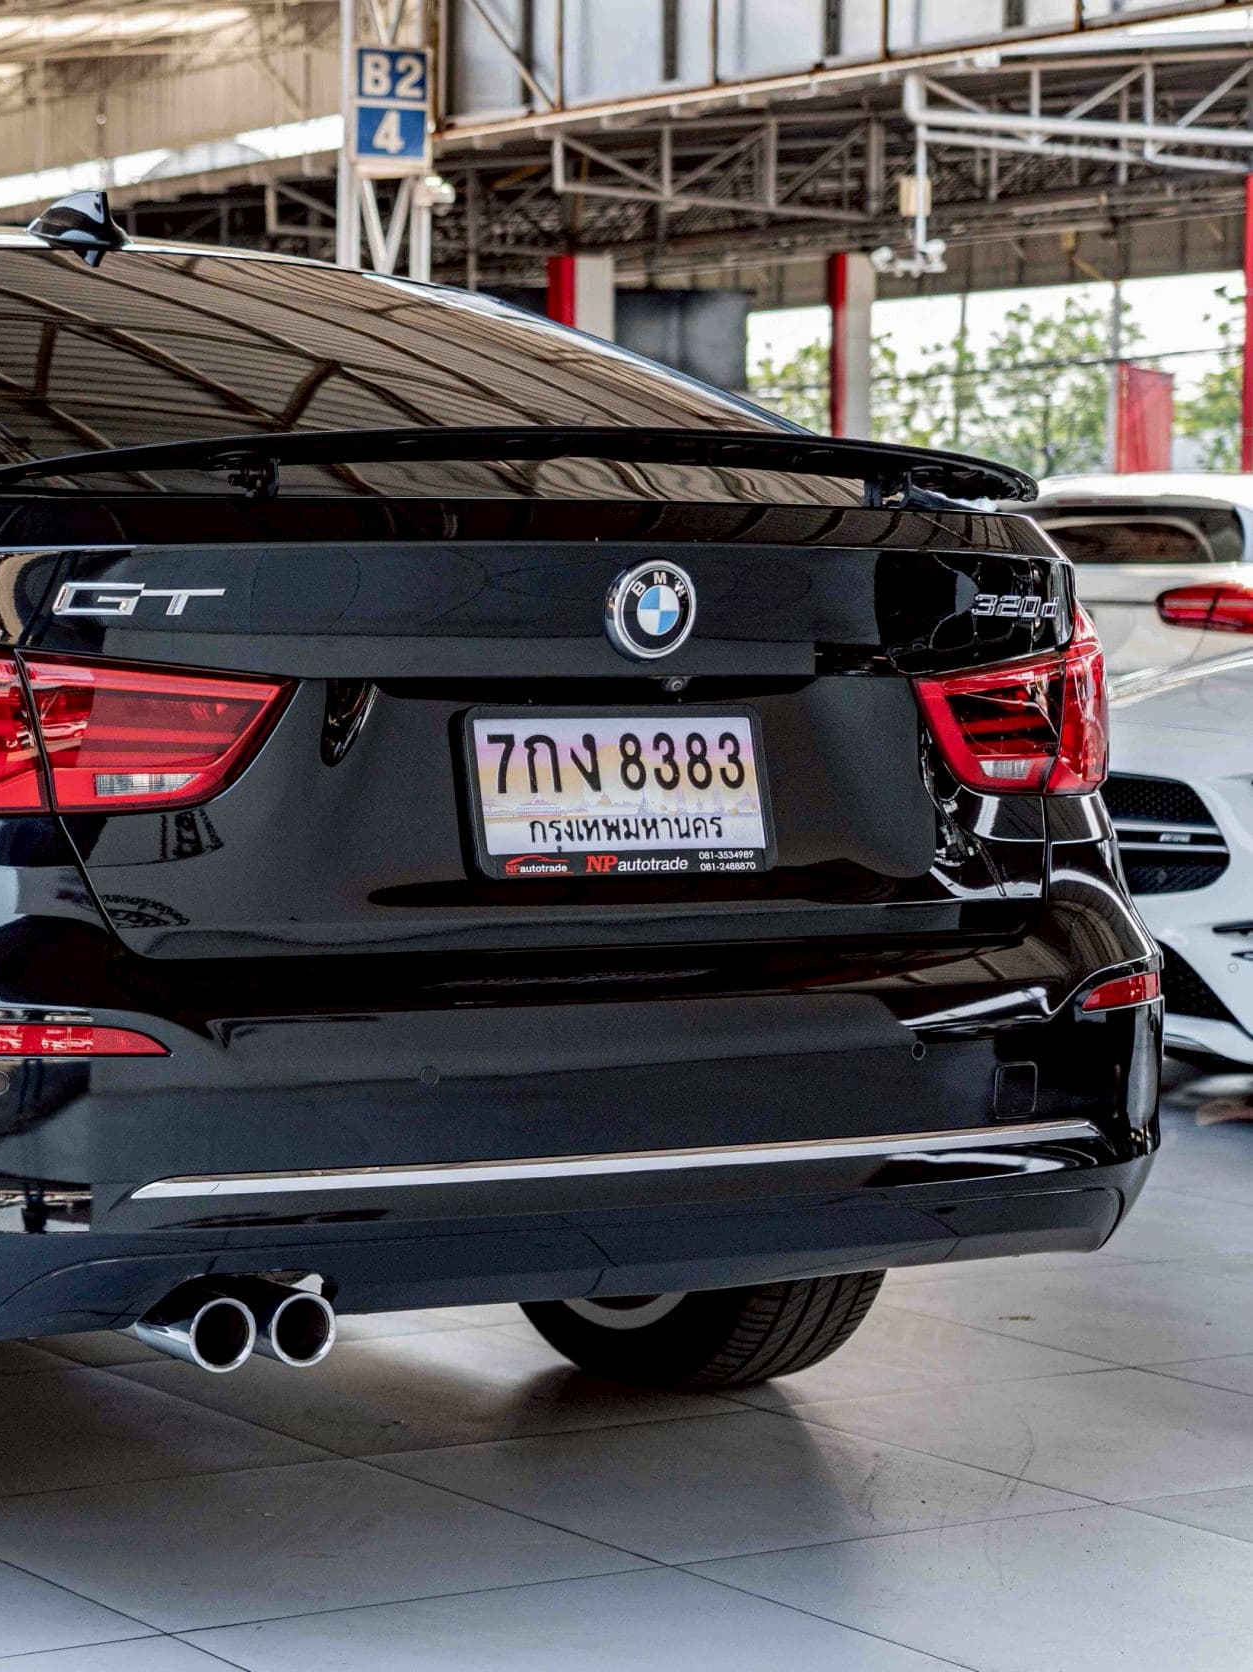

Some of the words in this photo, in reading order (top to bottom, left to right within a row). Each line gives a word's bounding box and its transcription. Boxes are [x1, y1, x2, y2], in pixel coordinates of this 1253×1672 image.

[361, 53, 423, 98] B2
[372, 109, 405, 154] 4
[52, 582, 226, 616] GT
[631, 571, 687, 598] BMW
[971, 594, 1059, 618] 320d
[486, 732, 602, 794] 7กง
[618, 731, 745, 791] 8383
[529, 815, 723, 853] กรุงเทพมหานคร
[698, 850, 754, 860] 081-3534989
[699, 861, 756, 872] 081-2488870
